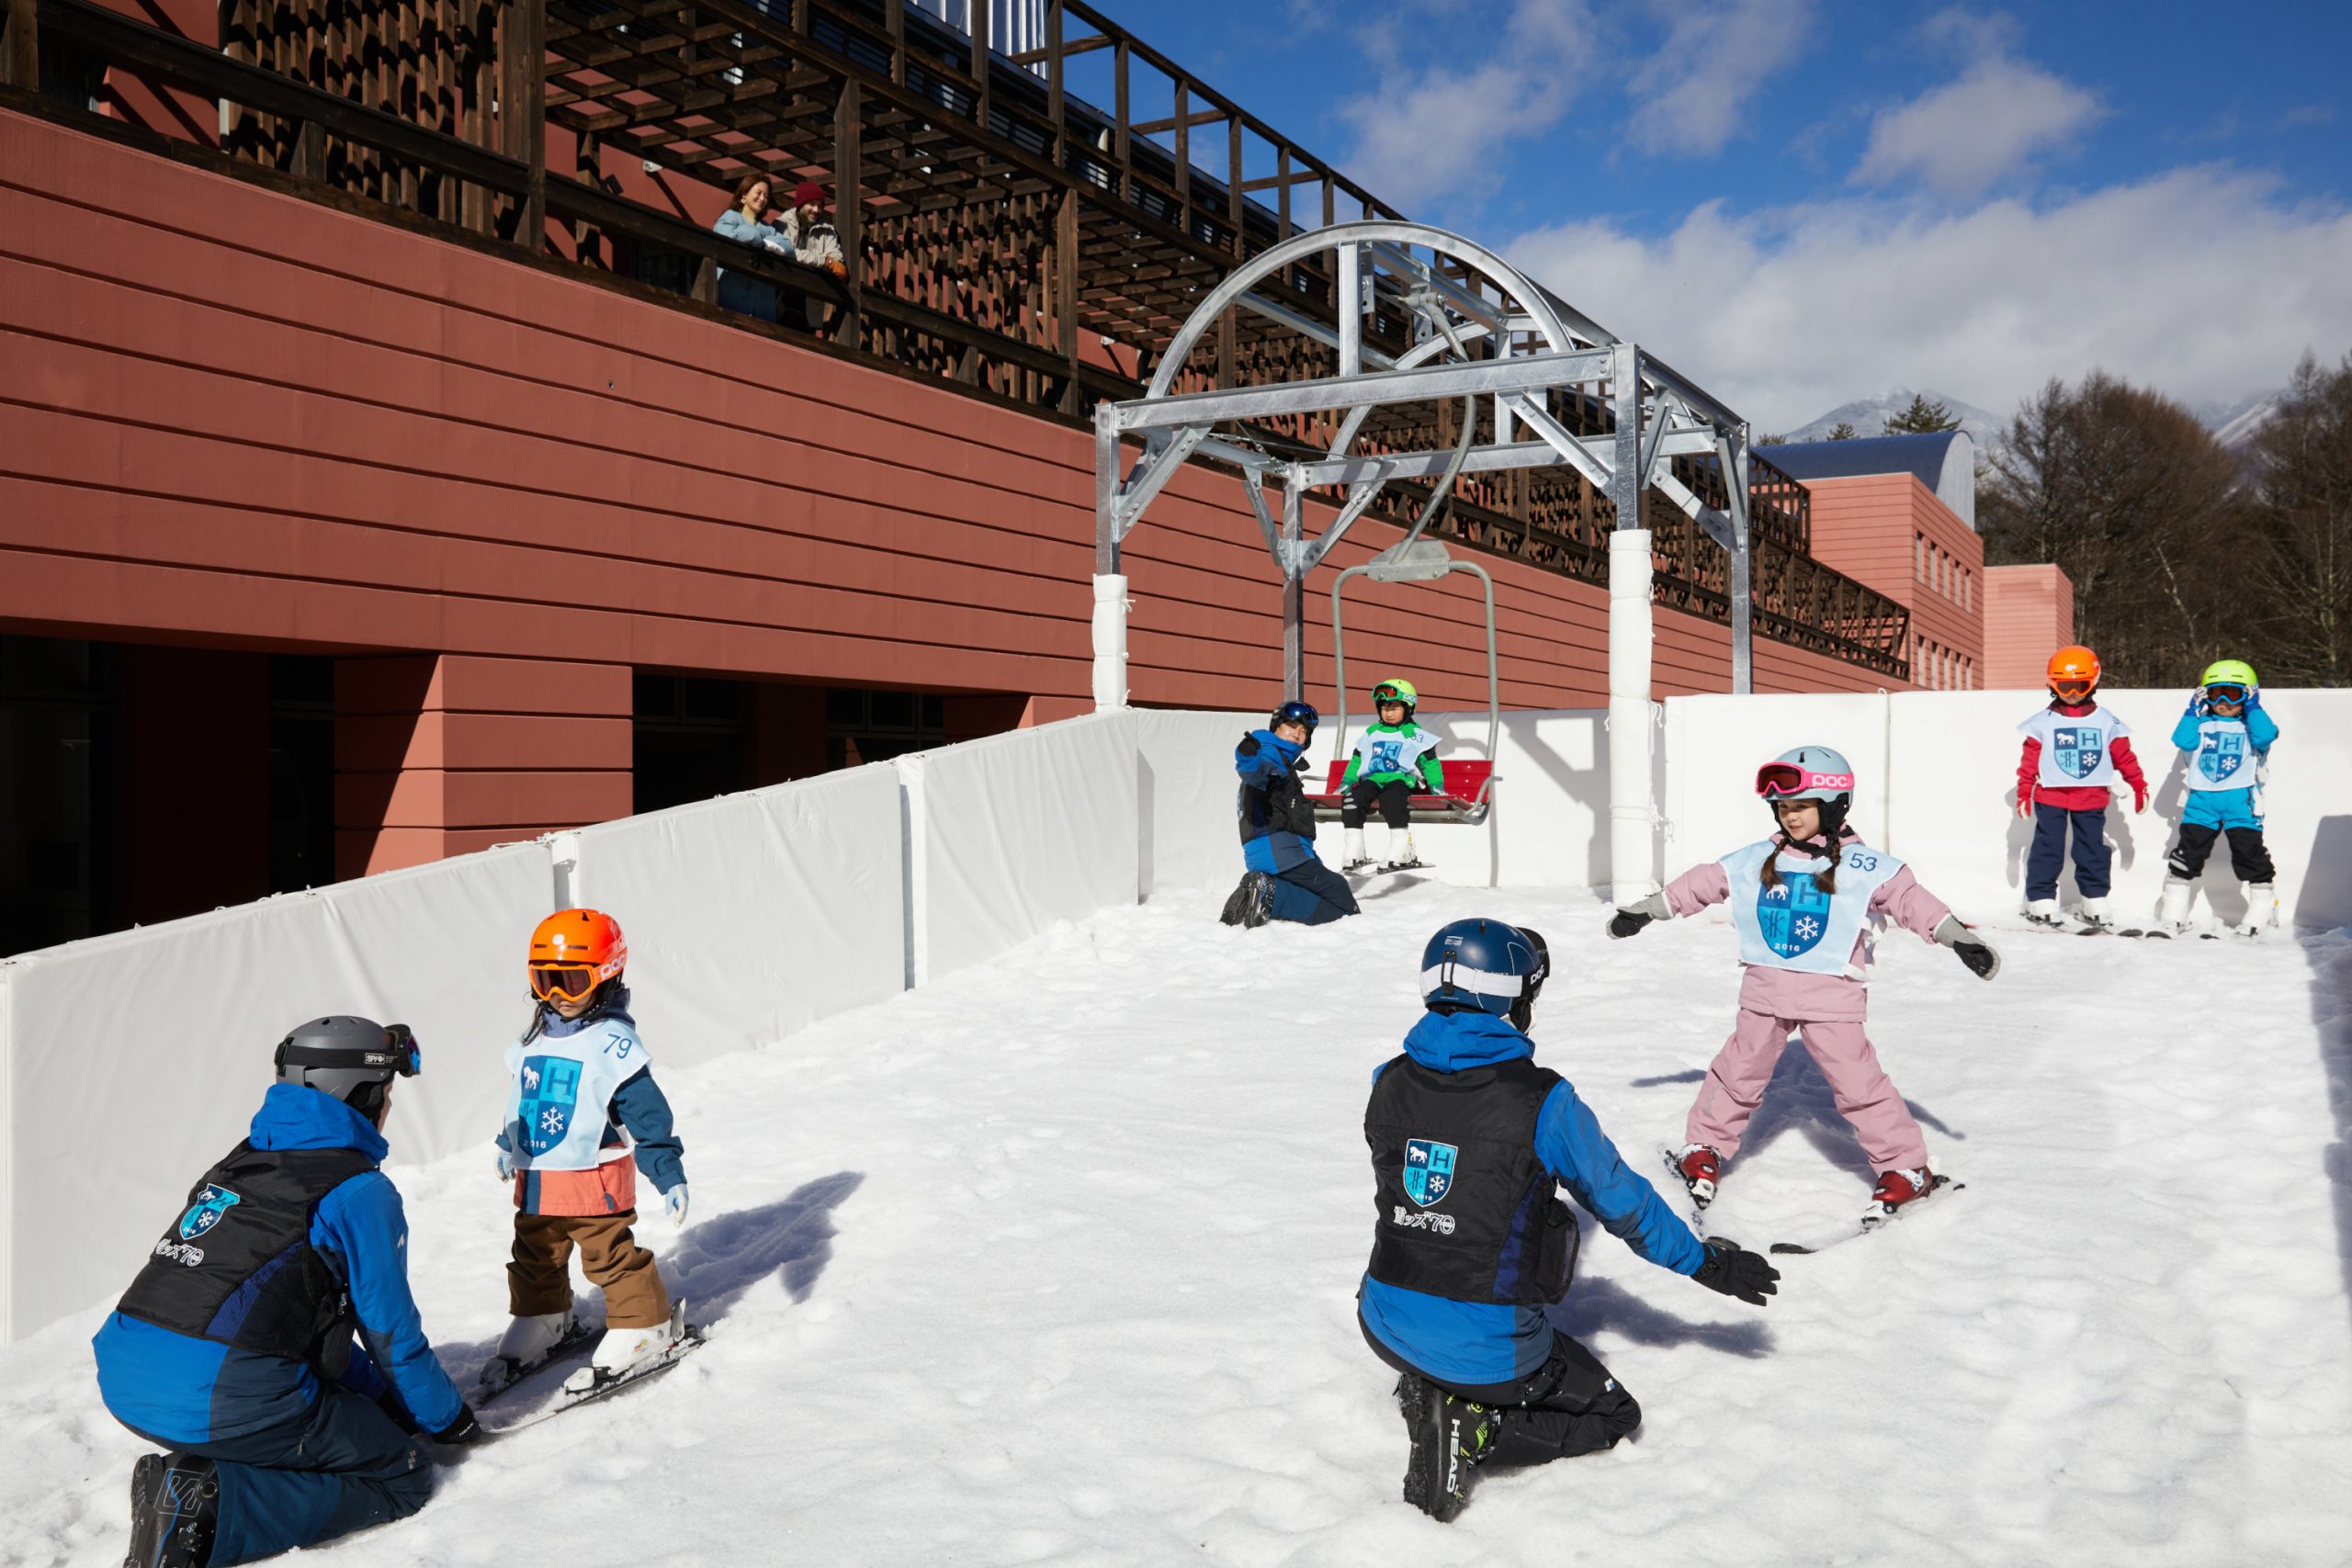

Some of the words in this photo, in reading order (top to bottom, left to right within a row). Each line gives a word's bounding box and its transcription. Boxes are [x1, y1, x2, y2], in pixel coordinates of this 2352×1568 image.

[2081, 732, 2098, 747] H
[2223, 738, 2240, 750] H
[1812, 774, 1848, 788] POC
[1849, 852, 1878, 872] 53
[1797, 882, 1825, 907] H
[1774, 942, 1801, 952] 2016
[600, 953, 626, 982] POC
[603, 1032, 633, 1059] 79
[546, 1066, 575, 1097] H
[523, 1139, 548, 1149] 2016
[1432, 1150, 1451, 1169] H
[1446, 1418, 1461, 1494] HEAD
